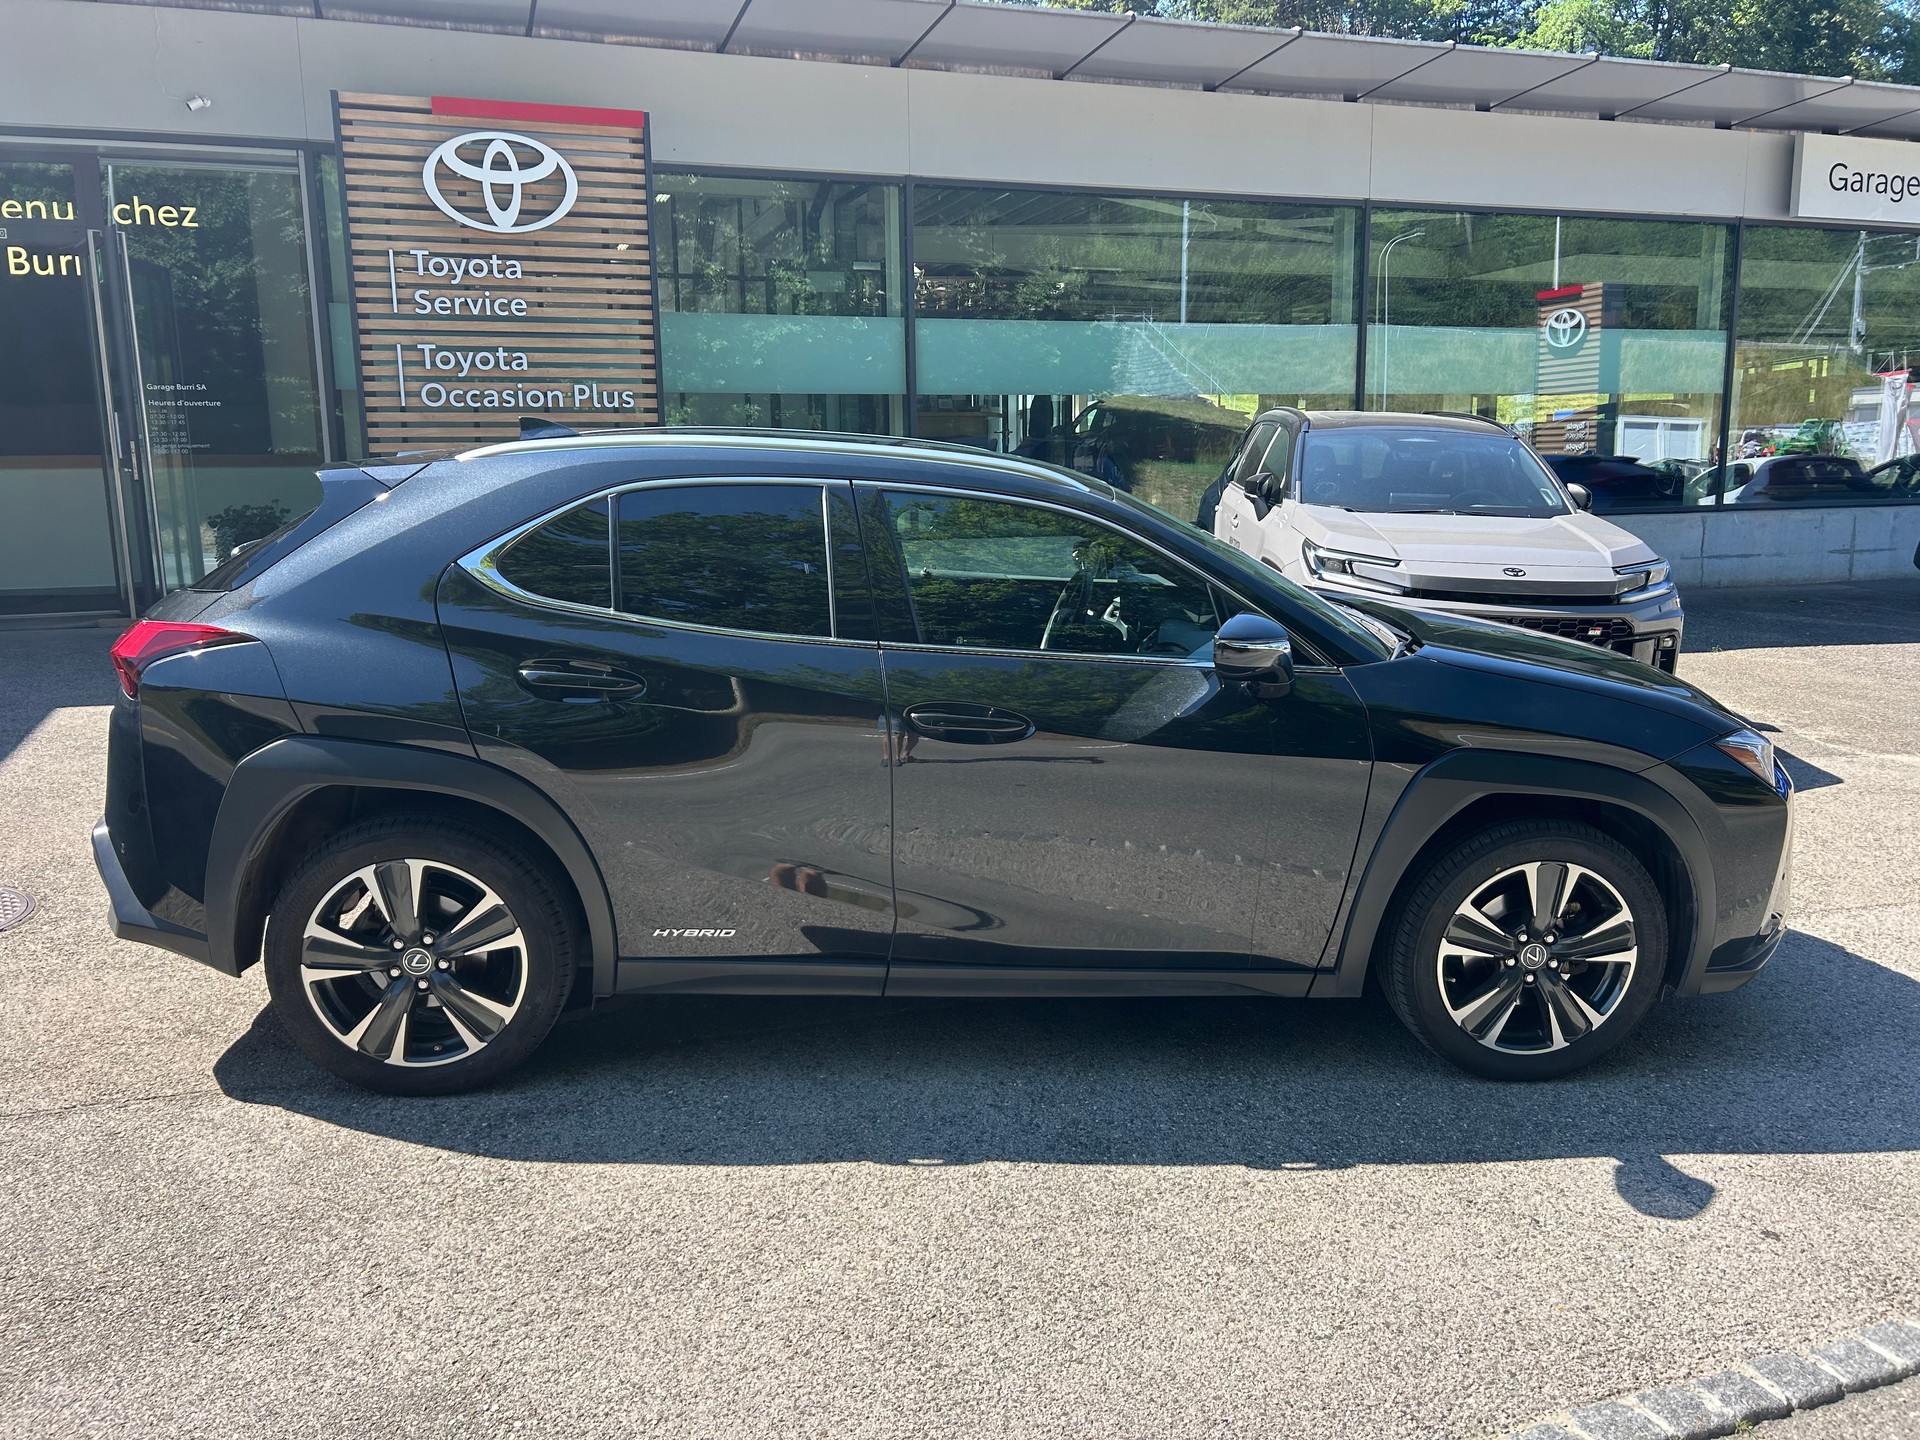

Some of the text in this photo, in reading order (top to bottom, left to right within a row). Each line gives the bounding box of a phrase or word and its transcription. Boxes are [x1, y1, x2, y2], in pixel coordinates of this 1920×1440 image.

[1829, 163, 1920, 202] Garage
[113, 196, 199, 227] chez
[410, 250, 522, 284] Toyota
[414, 290, 528, 317] Service
[417, 344, 528, 377] Toyota
[146, 383, 175, 391] Garage
[196, 383, 207, 391] SA
[421, 382, 635, 409] Occasion Plus
[652, 928, 737, 937] HYBRID
